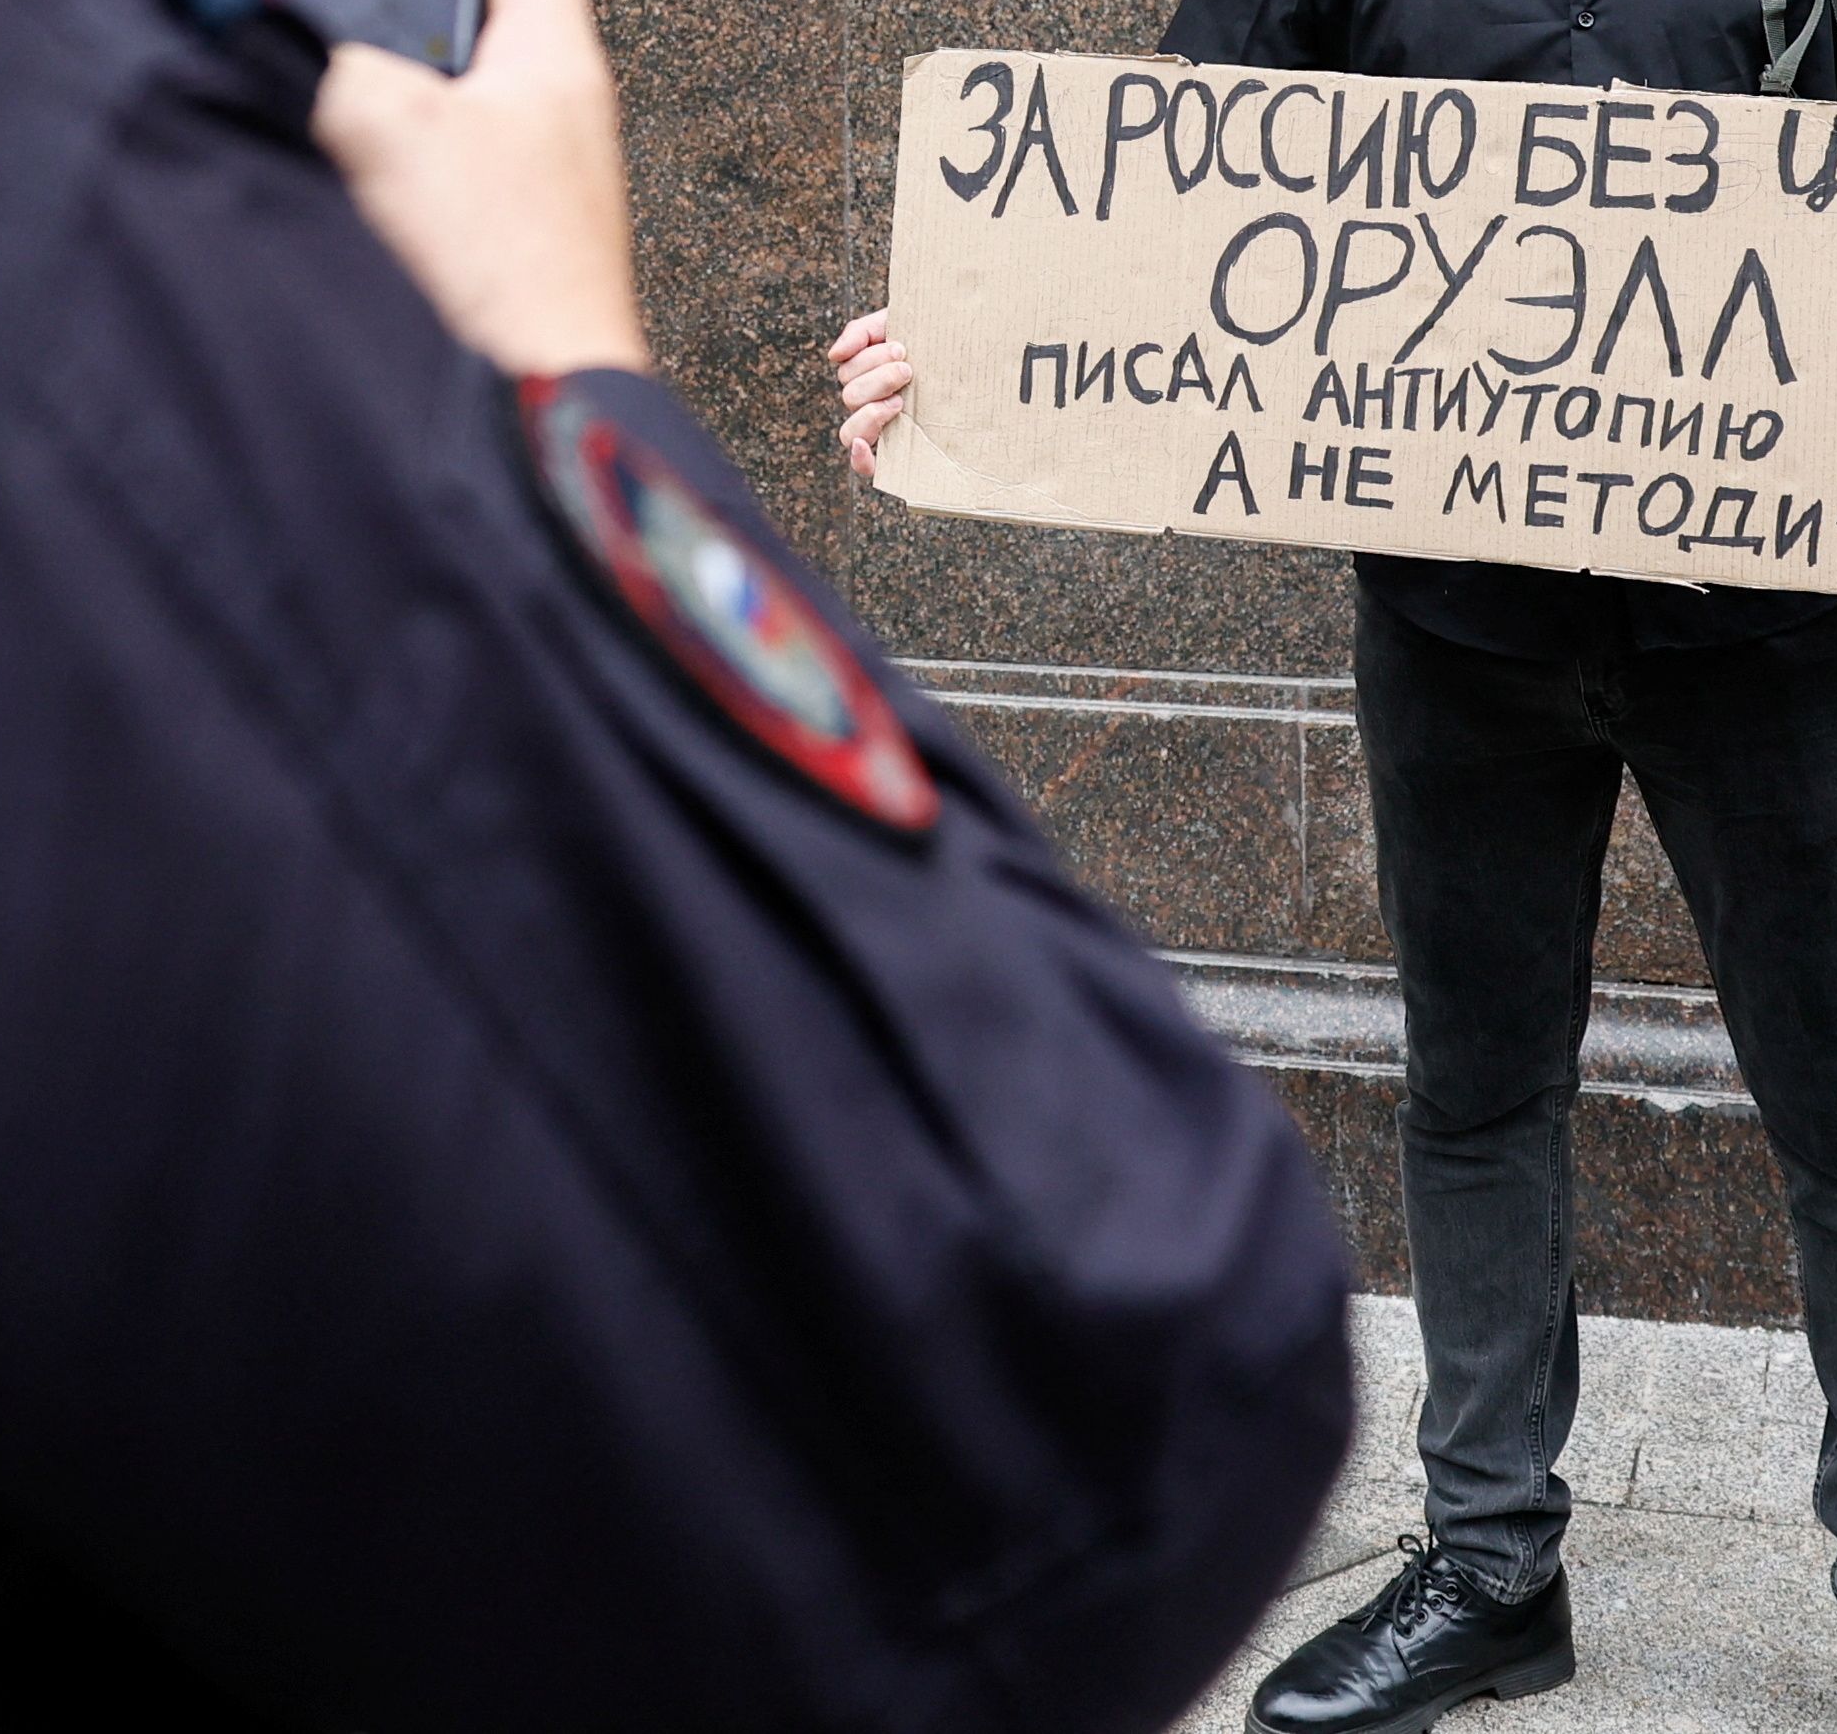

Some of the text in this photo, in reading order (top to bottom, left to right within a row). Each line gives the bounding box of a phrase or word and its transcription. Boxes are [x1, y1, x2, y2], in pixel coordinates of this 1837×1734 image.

[939, 60, 1080, 219] ЗА
[1095, 72, 1477, 221] РОССИЮ
[1513, 99, 1720, 214] БЕЗ
[1209, 211, 1798, 386] ОРУЭЛЛ
[1019, 332, 1784, 462] ПИСАЛ АНТИУТОПИЮ
[1192, 430, 1261, 515] А
[1287, 441, 1395, 510] НЕ
